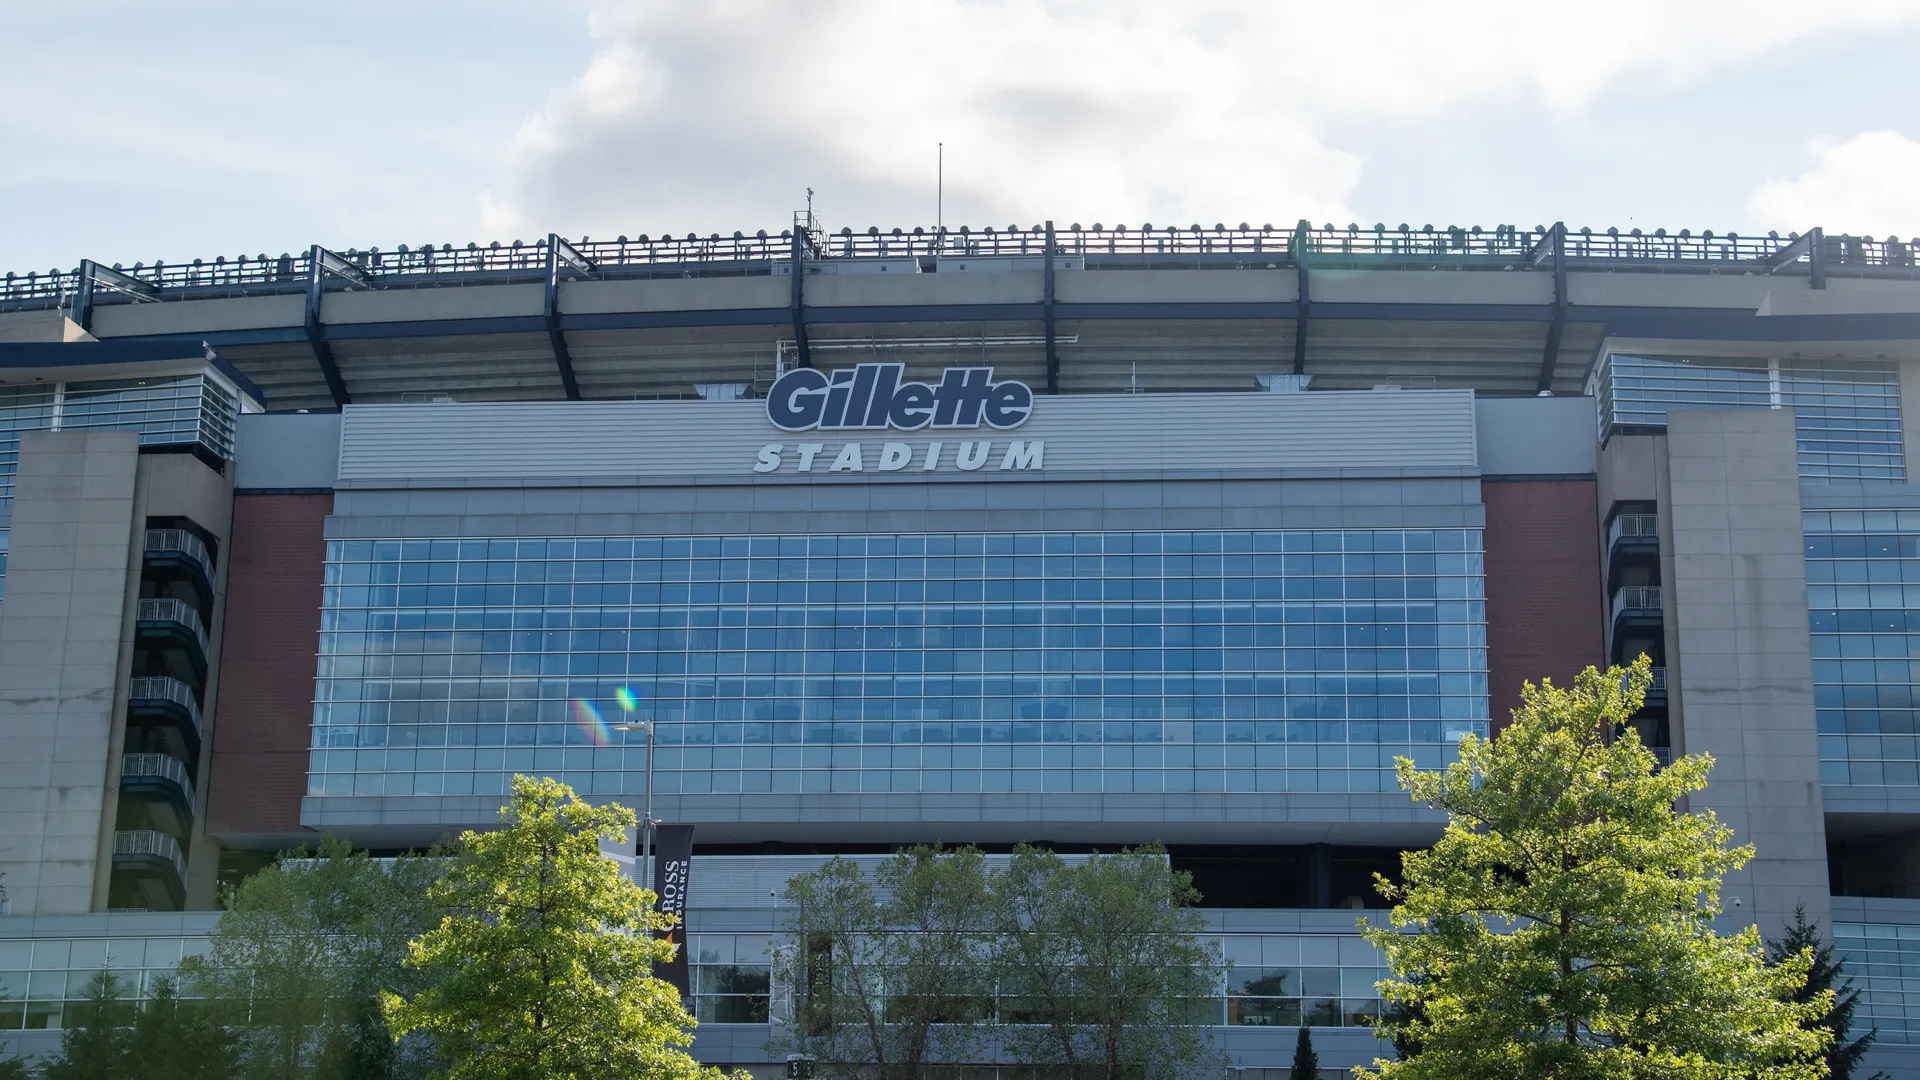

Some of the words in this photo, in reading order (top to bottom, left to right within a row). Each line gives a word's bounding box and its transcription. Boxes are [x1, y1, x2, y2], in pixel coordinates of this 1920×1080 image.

[766, 362, 1034, 432] Gillette
[753, 440, 1045, 473] STADIUM
[675, 860, 688, 930] INSURANCE
